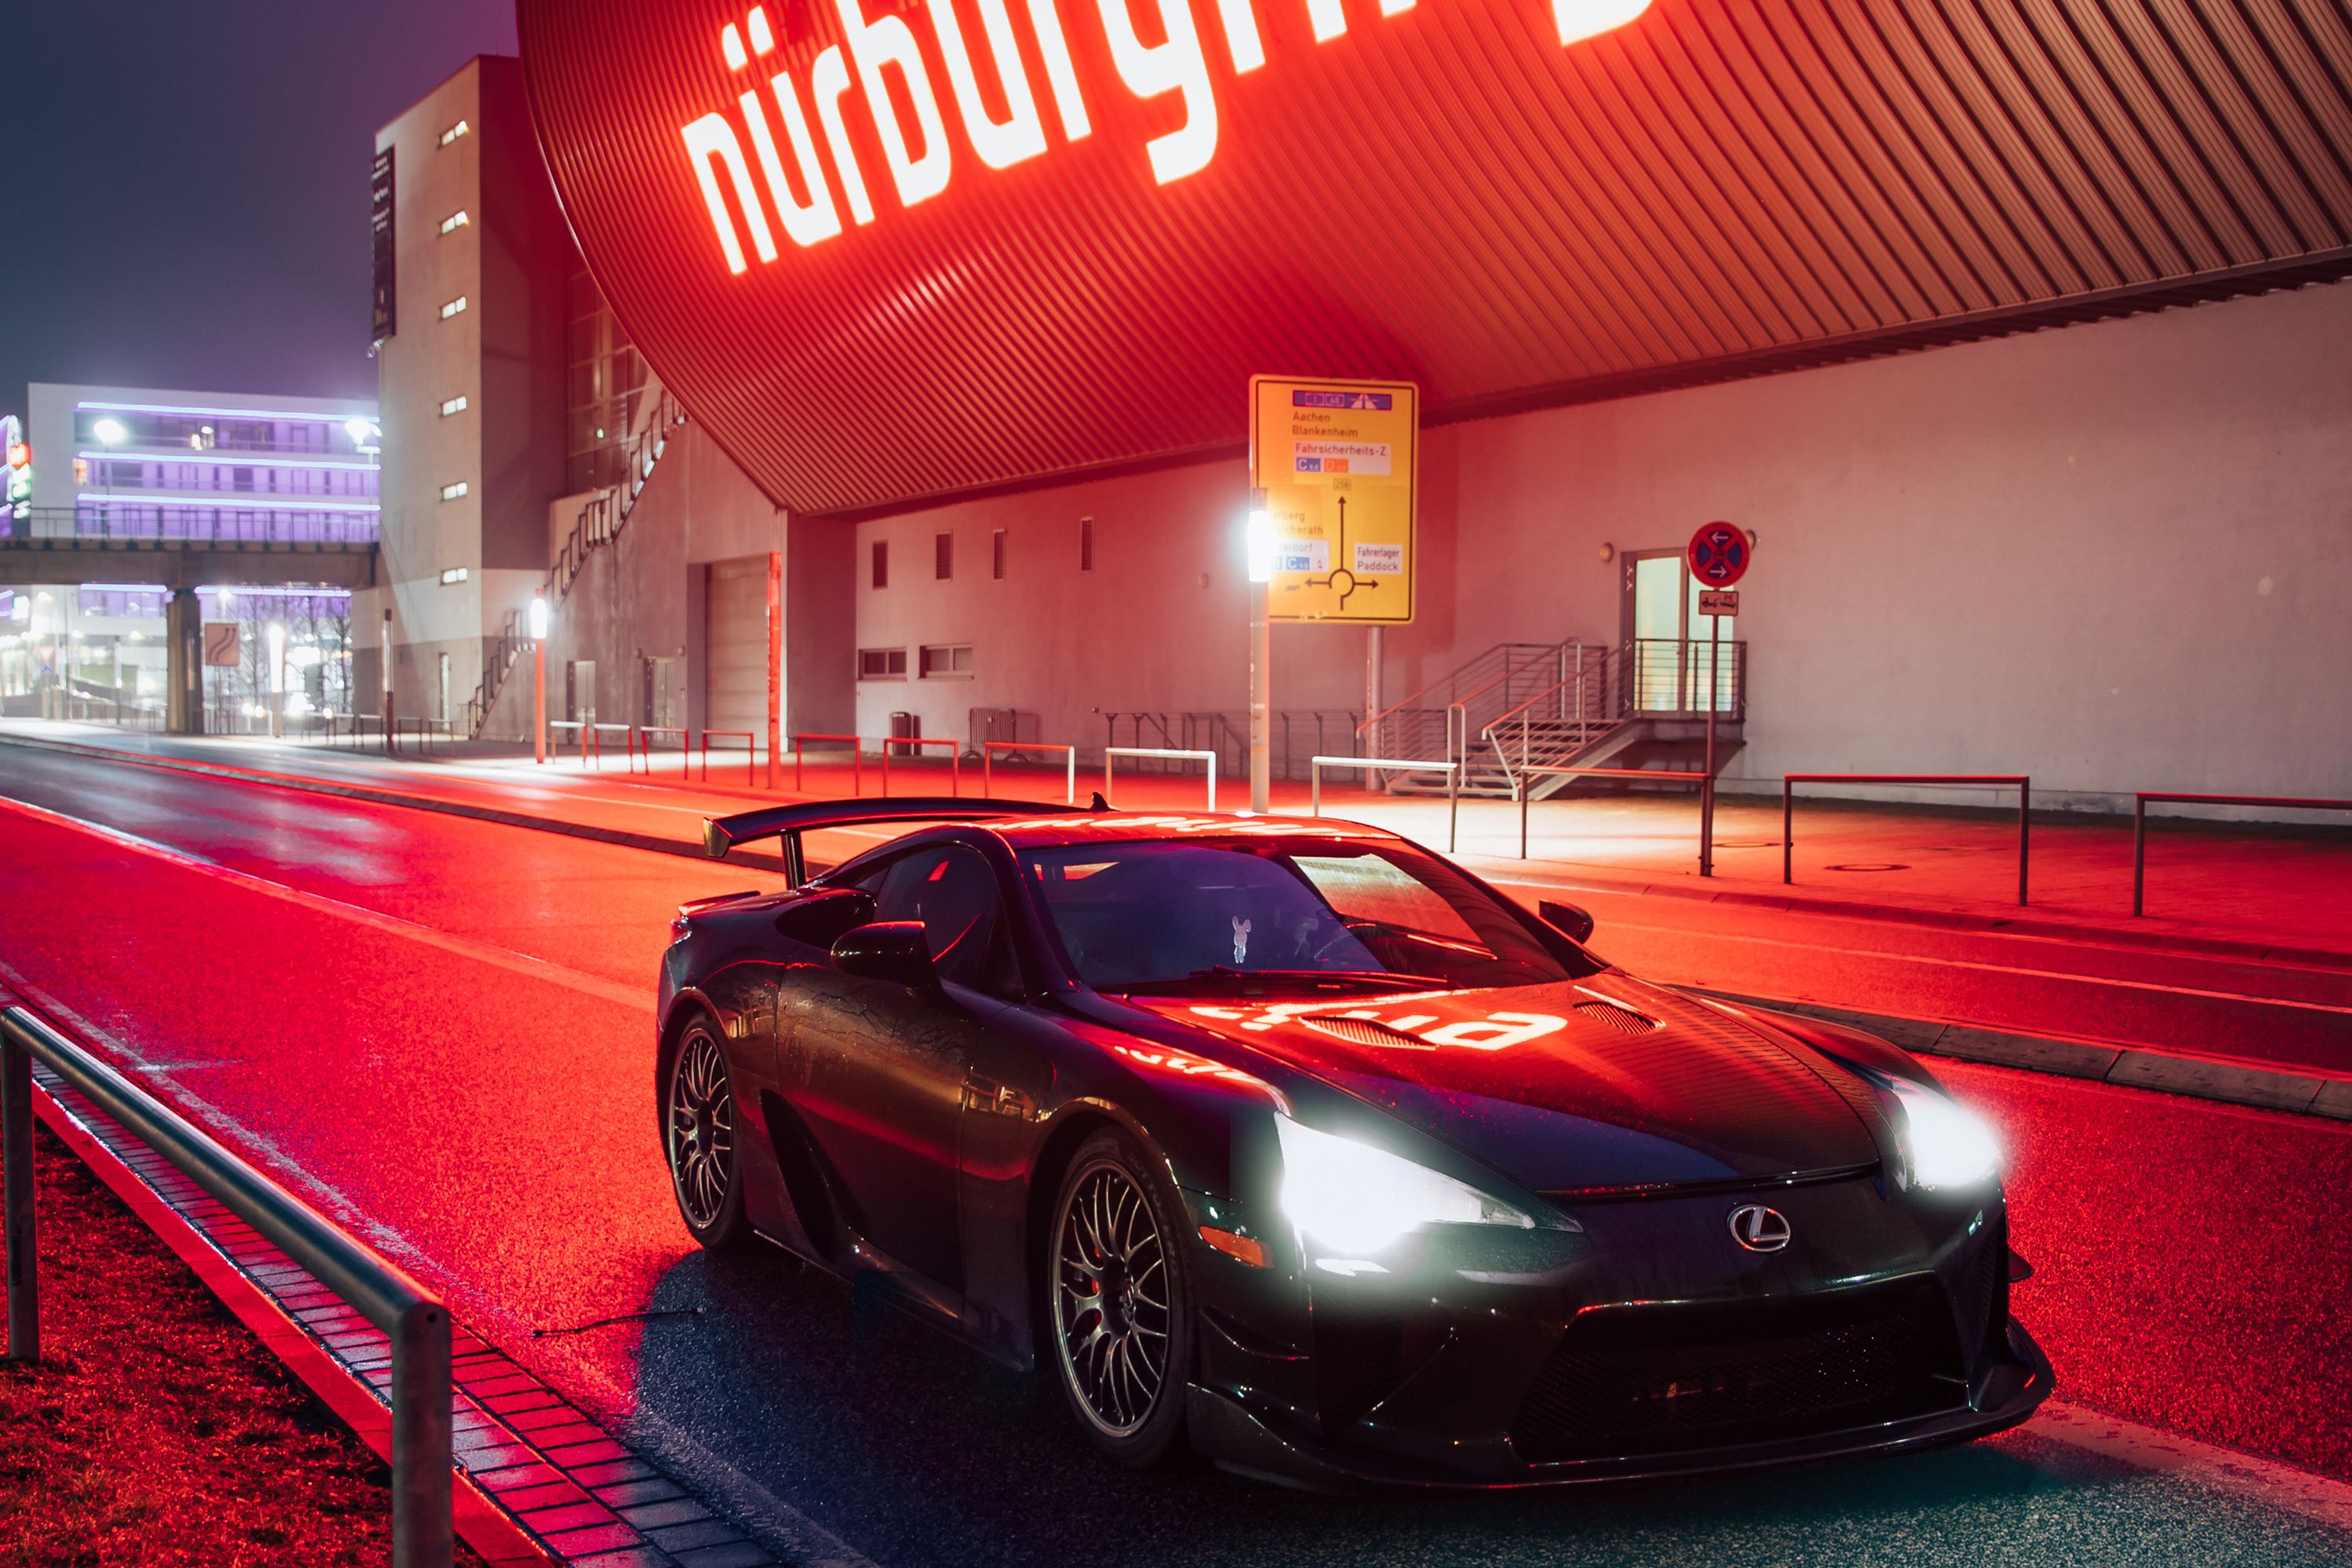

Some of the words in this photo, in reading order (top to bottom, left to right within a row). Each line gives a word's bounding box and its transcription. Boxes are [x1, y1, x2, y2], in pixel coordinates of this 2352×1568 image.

[1293, 411, 1330, 423] Aachen
[1292, 425, 1359, 437] Blankenheim
[1272, 510, 1305, 523] elberg
[1357, 546, 1399, 560] Fahrerlager
[1357, 561, 1399, 572] Paddock
